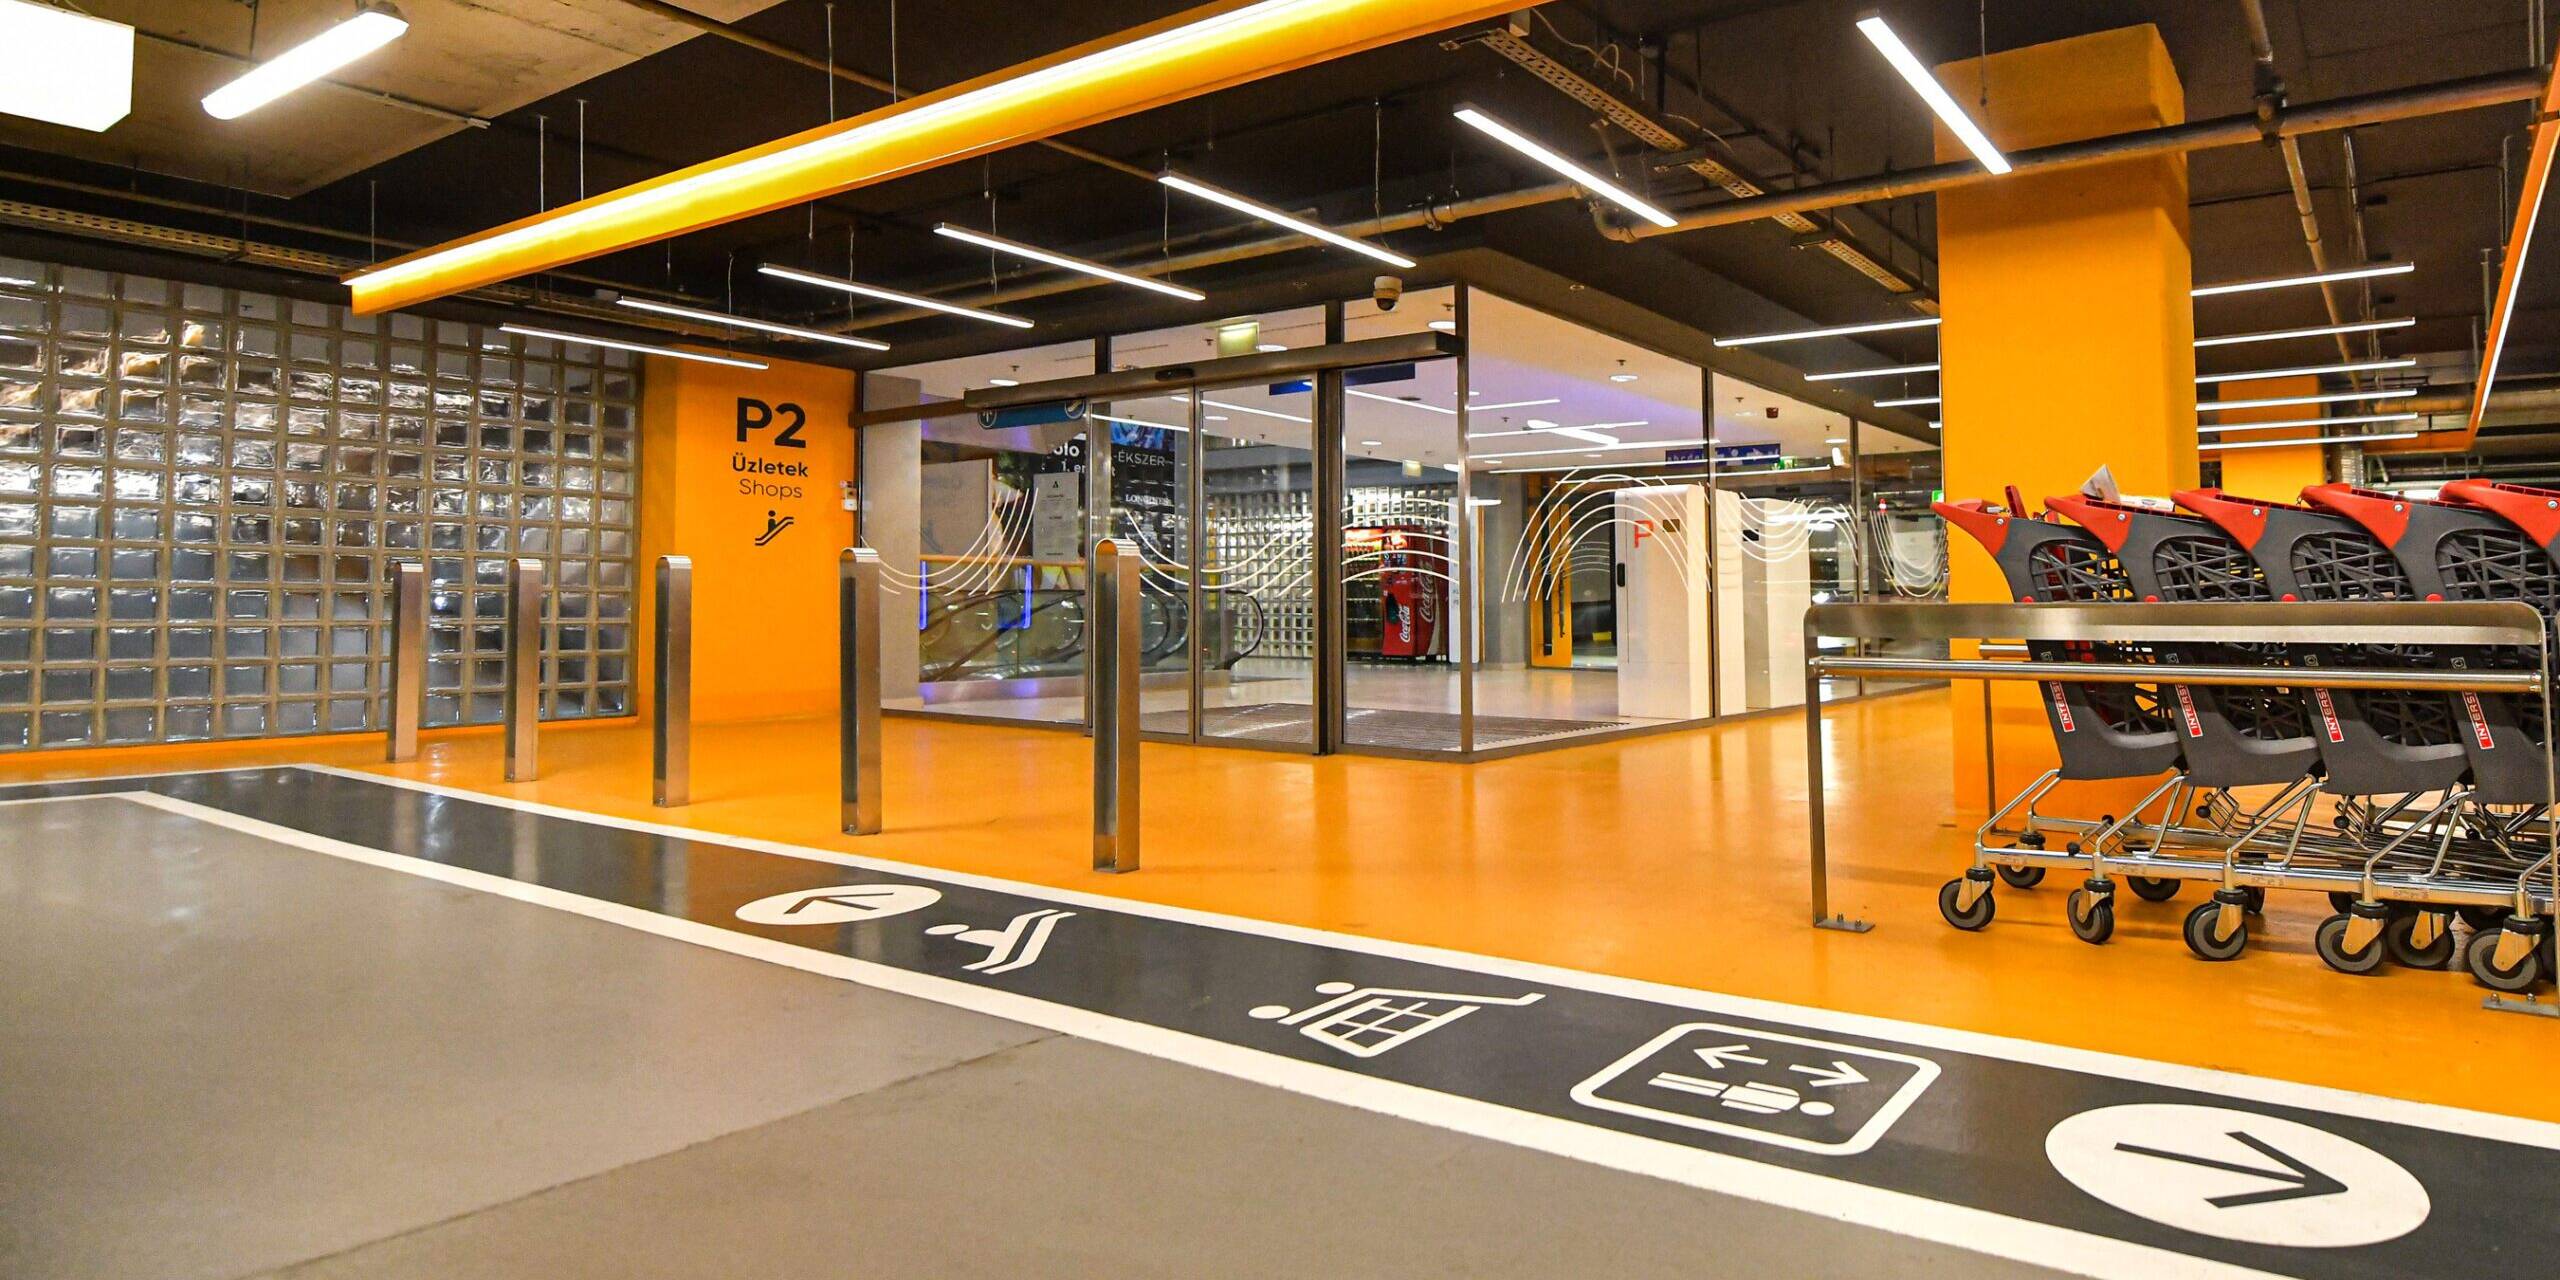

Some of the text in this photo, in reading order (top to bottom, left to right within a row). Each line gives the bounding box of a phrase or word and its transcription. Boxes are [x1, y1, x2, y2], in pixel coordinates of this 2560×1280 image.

[736, 397, 806, 448] P2
[732, 452, 808, 477] Üzletek
[739, 478, 802, 500] Shops
[1634, 520, 1654, 548] P
